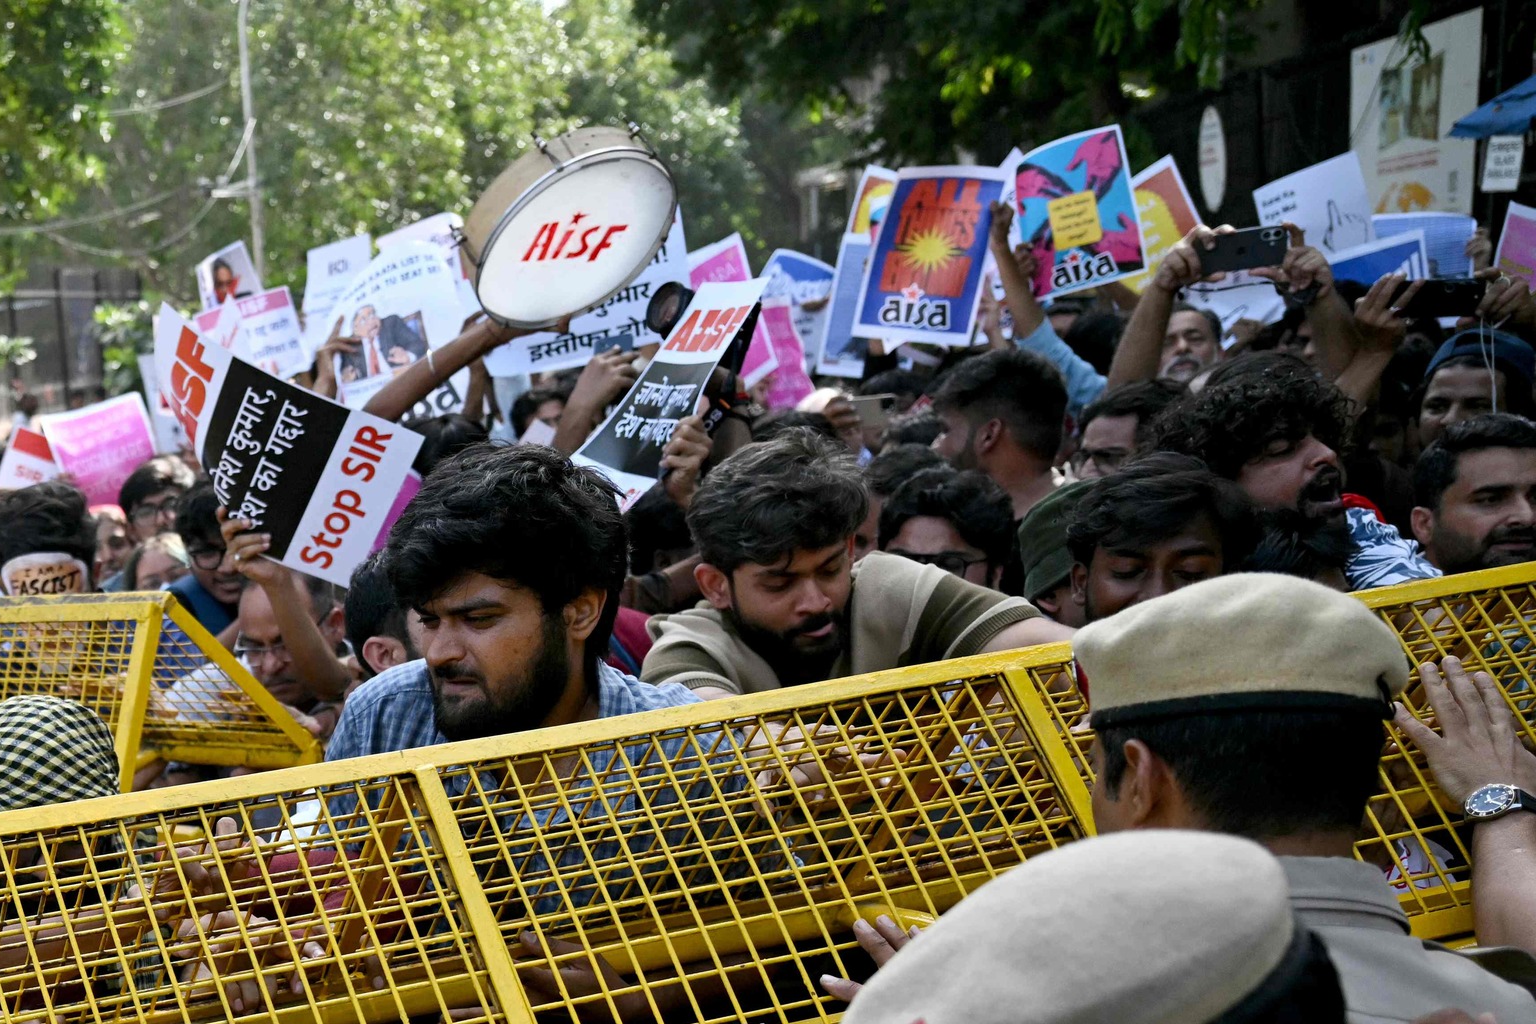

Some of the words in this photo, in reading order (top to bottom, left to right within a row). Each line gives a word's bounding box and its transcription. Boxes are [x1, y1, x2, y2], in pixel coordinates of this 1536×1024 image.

[1054, 253, 1114, 288] aisa
[882, 298, 947, 327] aisa
[264, 399, 309, 456] गद्दार
[250, 455, 284, 492] का
[300, 488, 366, 570] Stop
[340, 424, 394, 482] SIR
